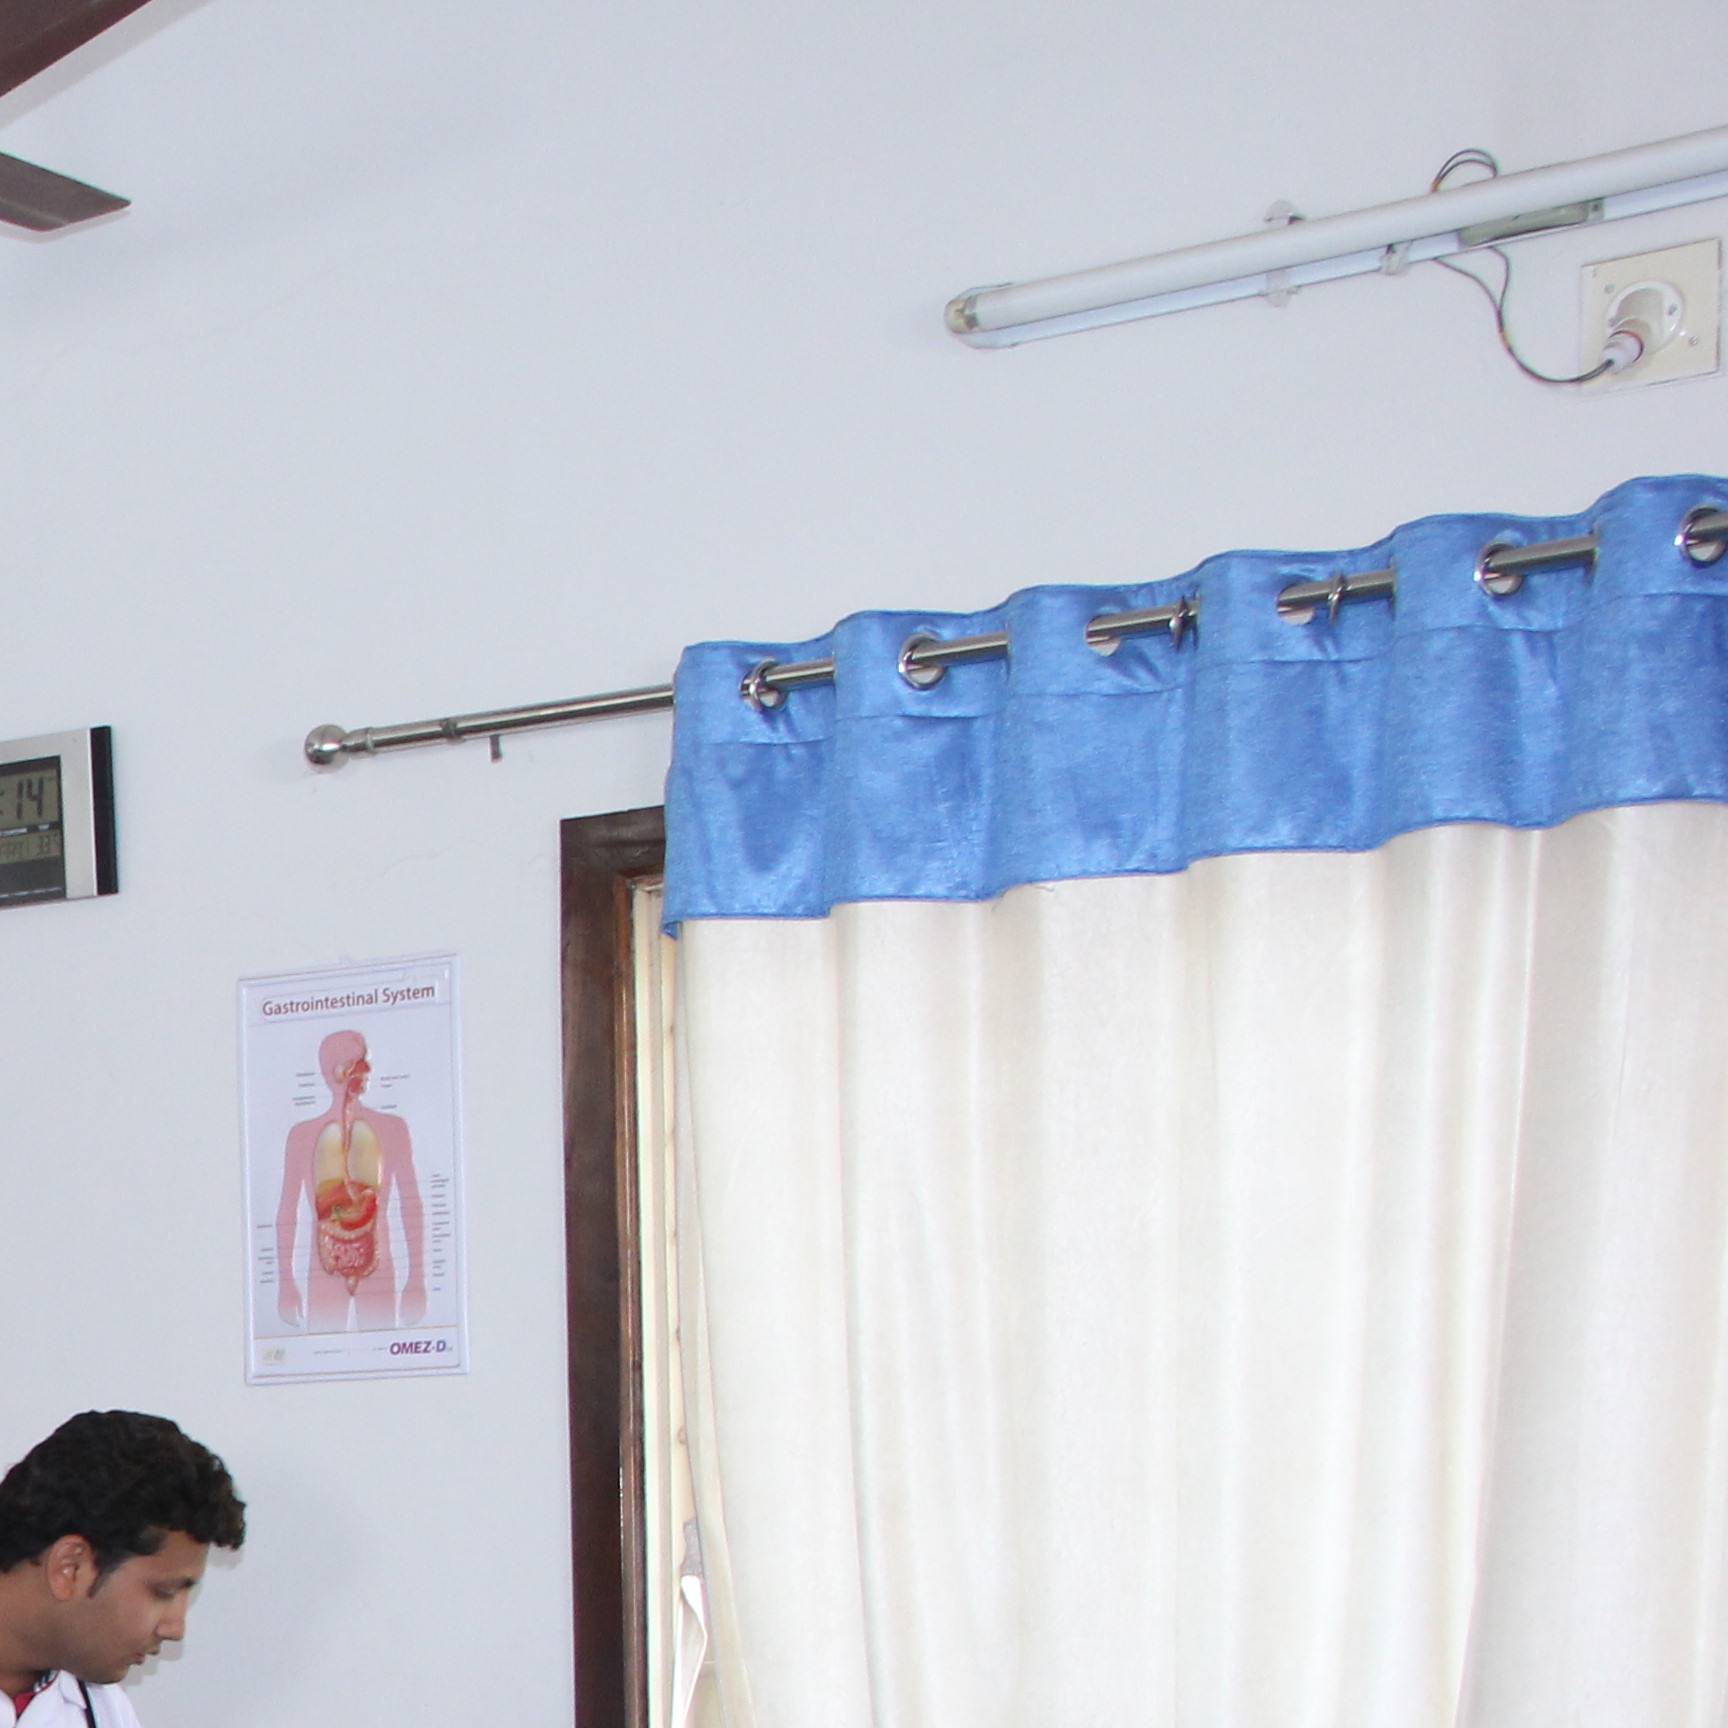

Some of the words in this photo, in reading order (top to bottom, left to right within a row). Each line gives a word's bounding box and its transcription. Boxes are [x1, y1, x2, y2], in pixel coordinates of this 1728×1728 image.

[261, 988, 379, 1017] Gastrointestinal
[381, 984, 436, 1007] System
[389, 1339, 447, 1356] OMEZ-D
